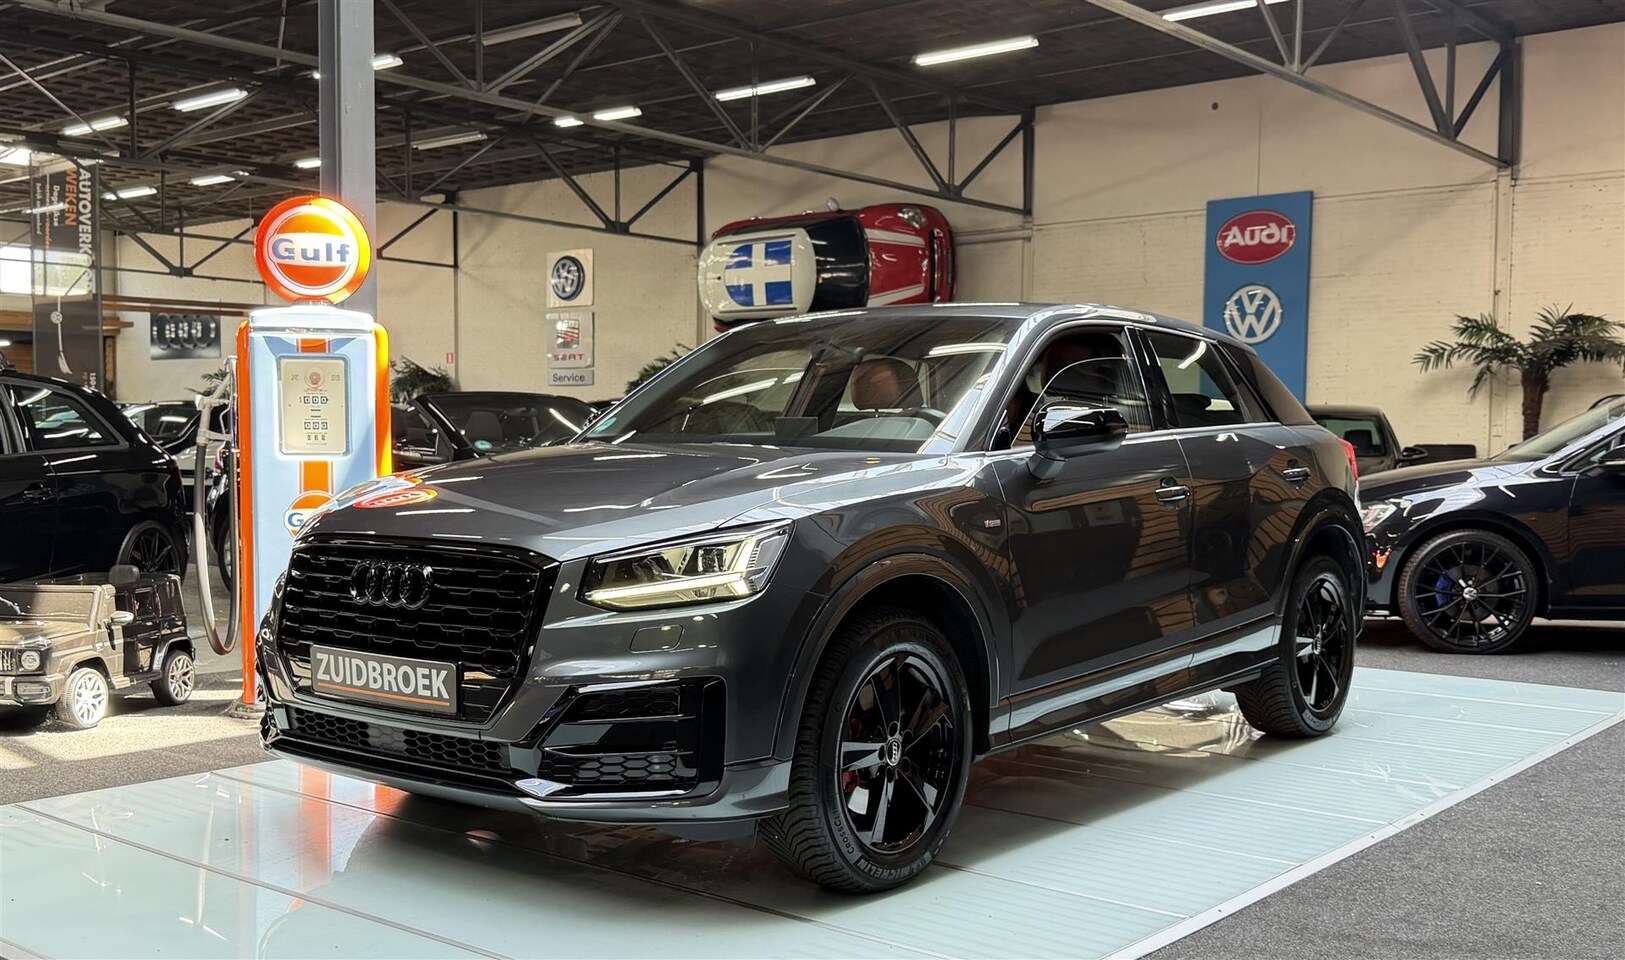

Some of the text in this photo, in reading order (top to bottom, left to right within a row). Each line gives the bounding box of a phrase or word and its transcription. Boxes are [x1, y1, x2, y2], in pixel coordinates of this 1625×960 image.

[65, 167, 77, 227] WEKEN
[1223, 222, 1289, 248] Audi
[271, 238, 350, 262] Gulf
[553, 353, 585, 361] SEAT
[552, 372, 586, 383] Service
[316, 652, 450, 699] ZUIDBROEK
